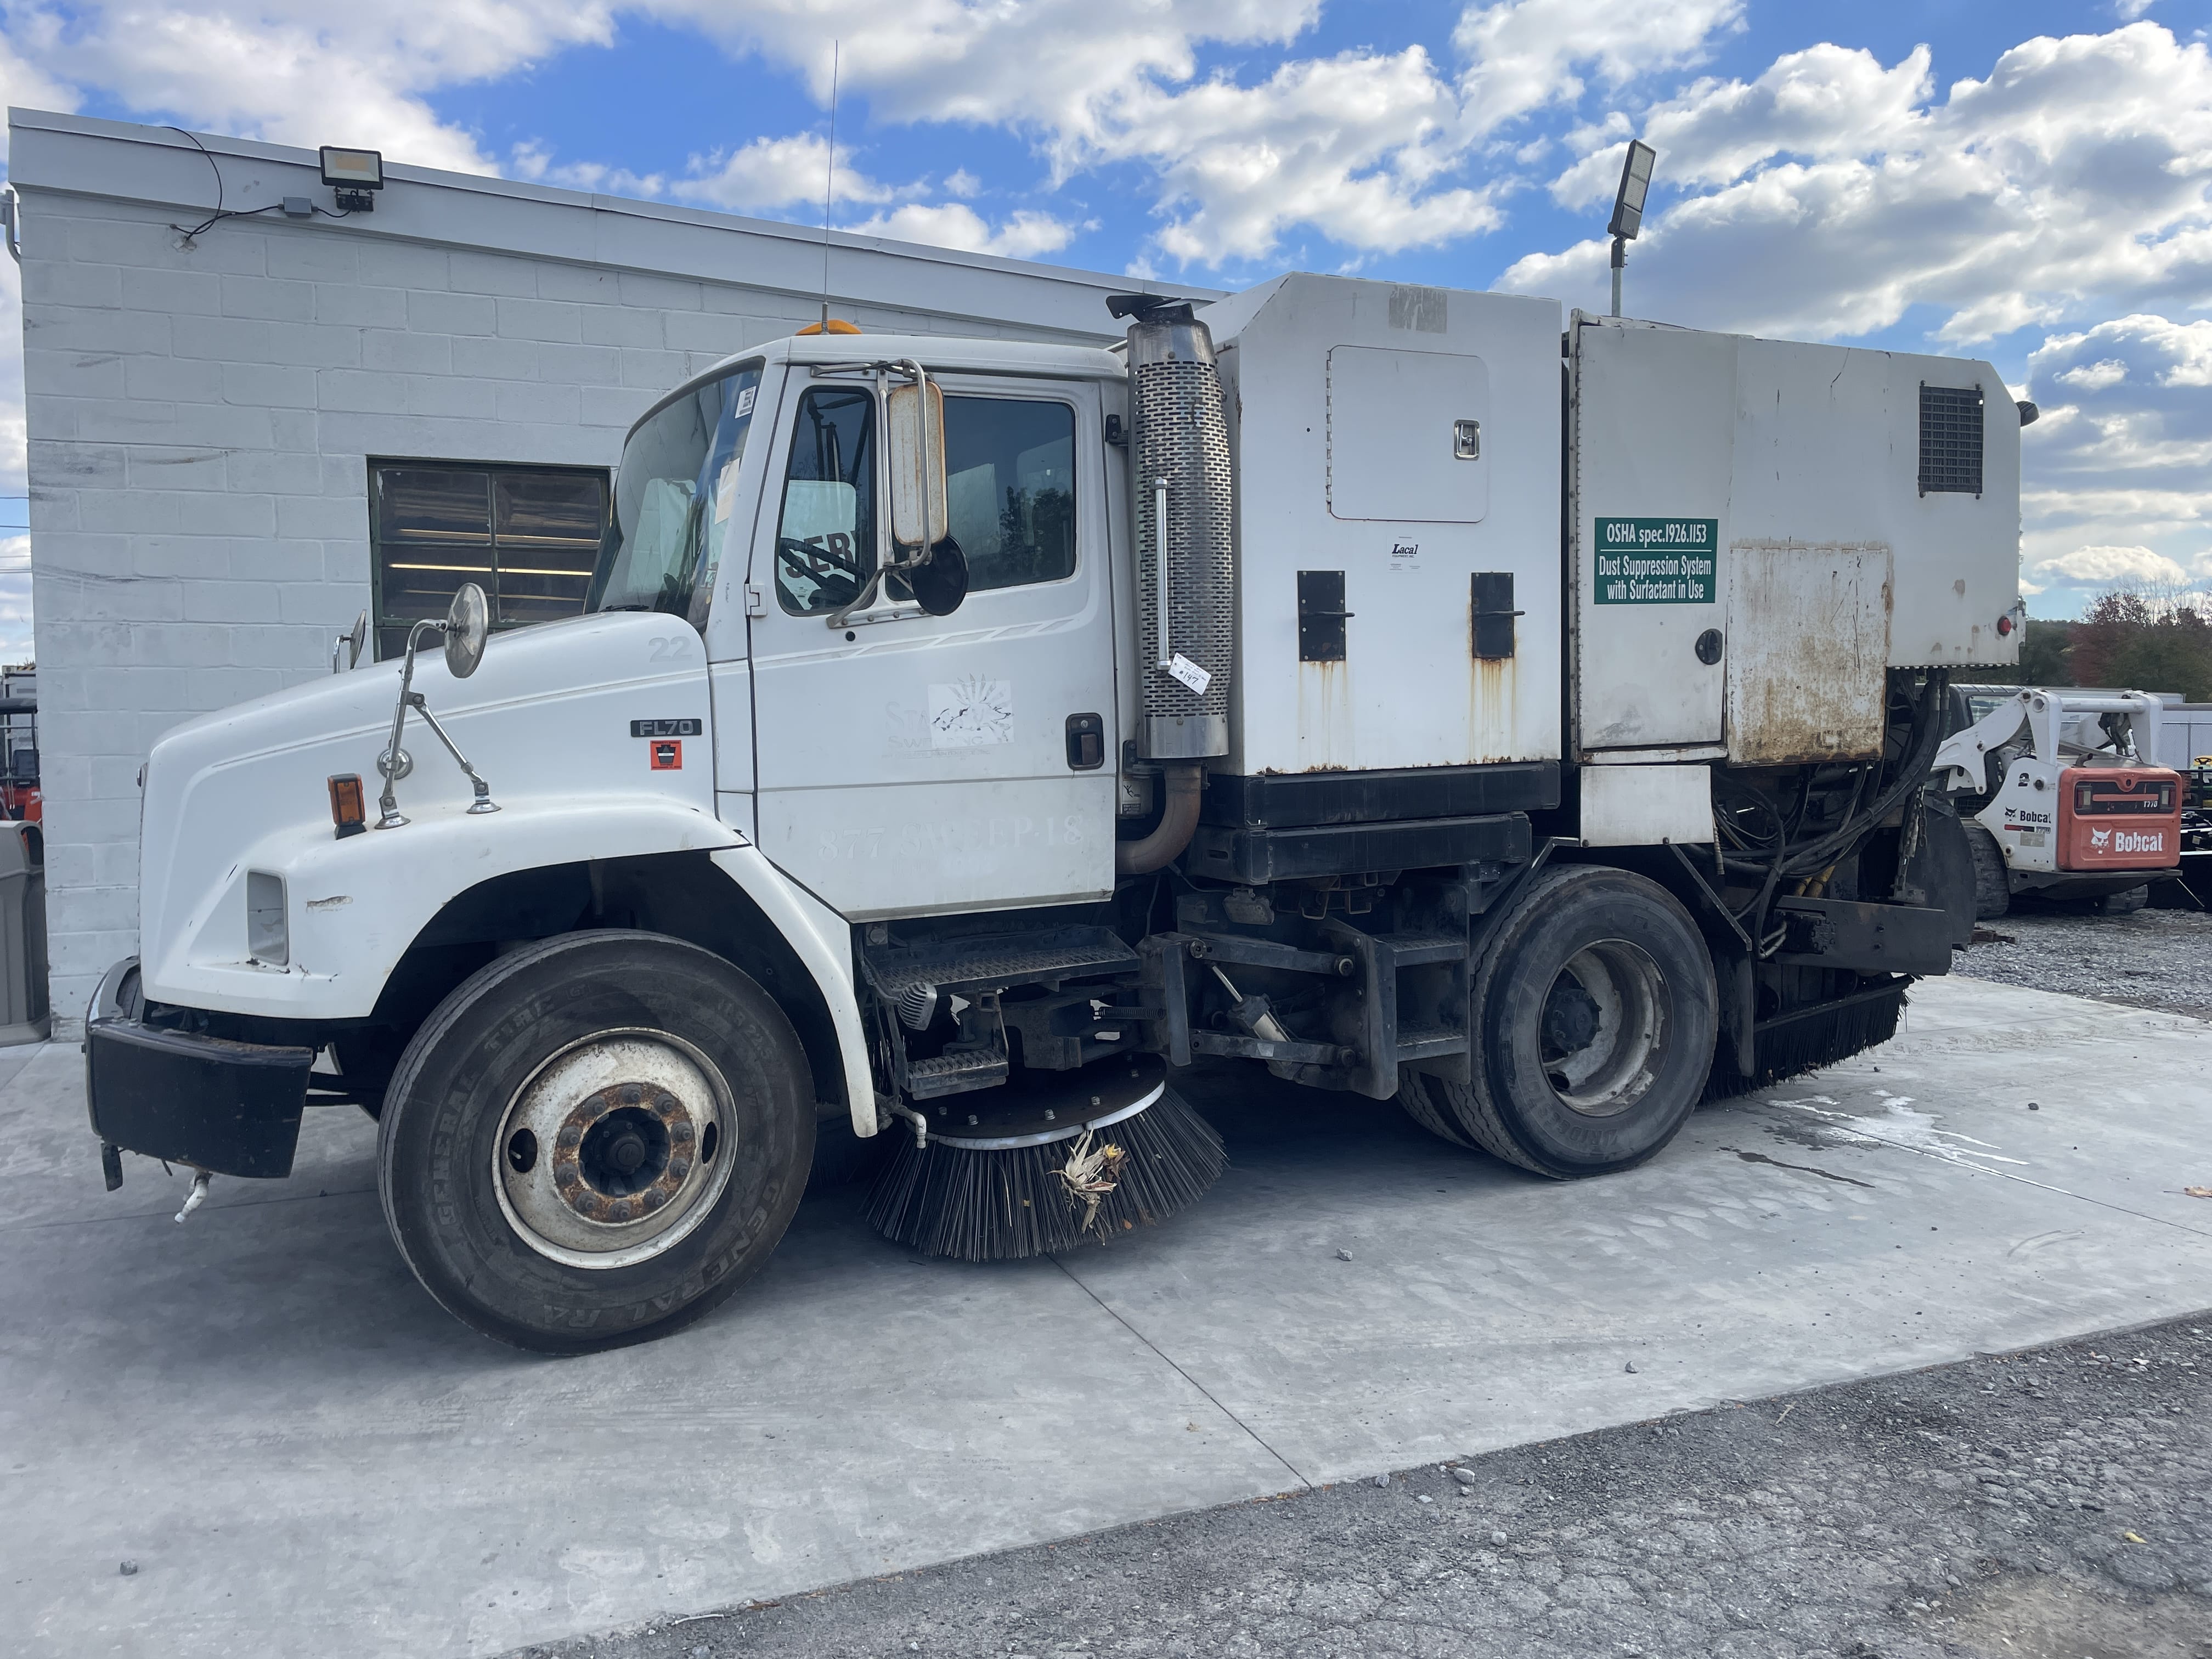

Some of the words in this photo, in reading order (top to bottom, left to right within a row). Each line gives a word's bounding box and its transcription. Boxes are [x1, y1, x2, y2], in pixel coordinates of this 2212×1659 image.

[1606, 523, 1635, 543] OSHA
[1639, 524, 1707, 548] spec.1926.1153
[785, 531, 856, 578] SER
[1392, 544, 1418, 554] Lacal
[1599, 556, 1620, 575] Dust
[1623, 555, 1678, 579] Suppression
[1681, 555, 1711, 579] System
[1607, 579, 1627, 600] with
[1629, 580, 1676, 600] Surfactant
[1678, 579, 1686, 599] in
[1688, 580, 1704, 599] Use
[648, 636, 692, 663] 22
[639, 721, 693, 735] FL70
[2020, 810, 2051, 823] Bobcat
[2115, 832, 2163, 852] Bobcat
